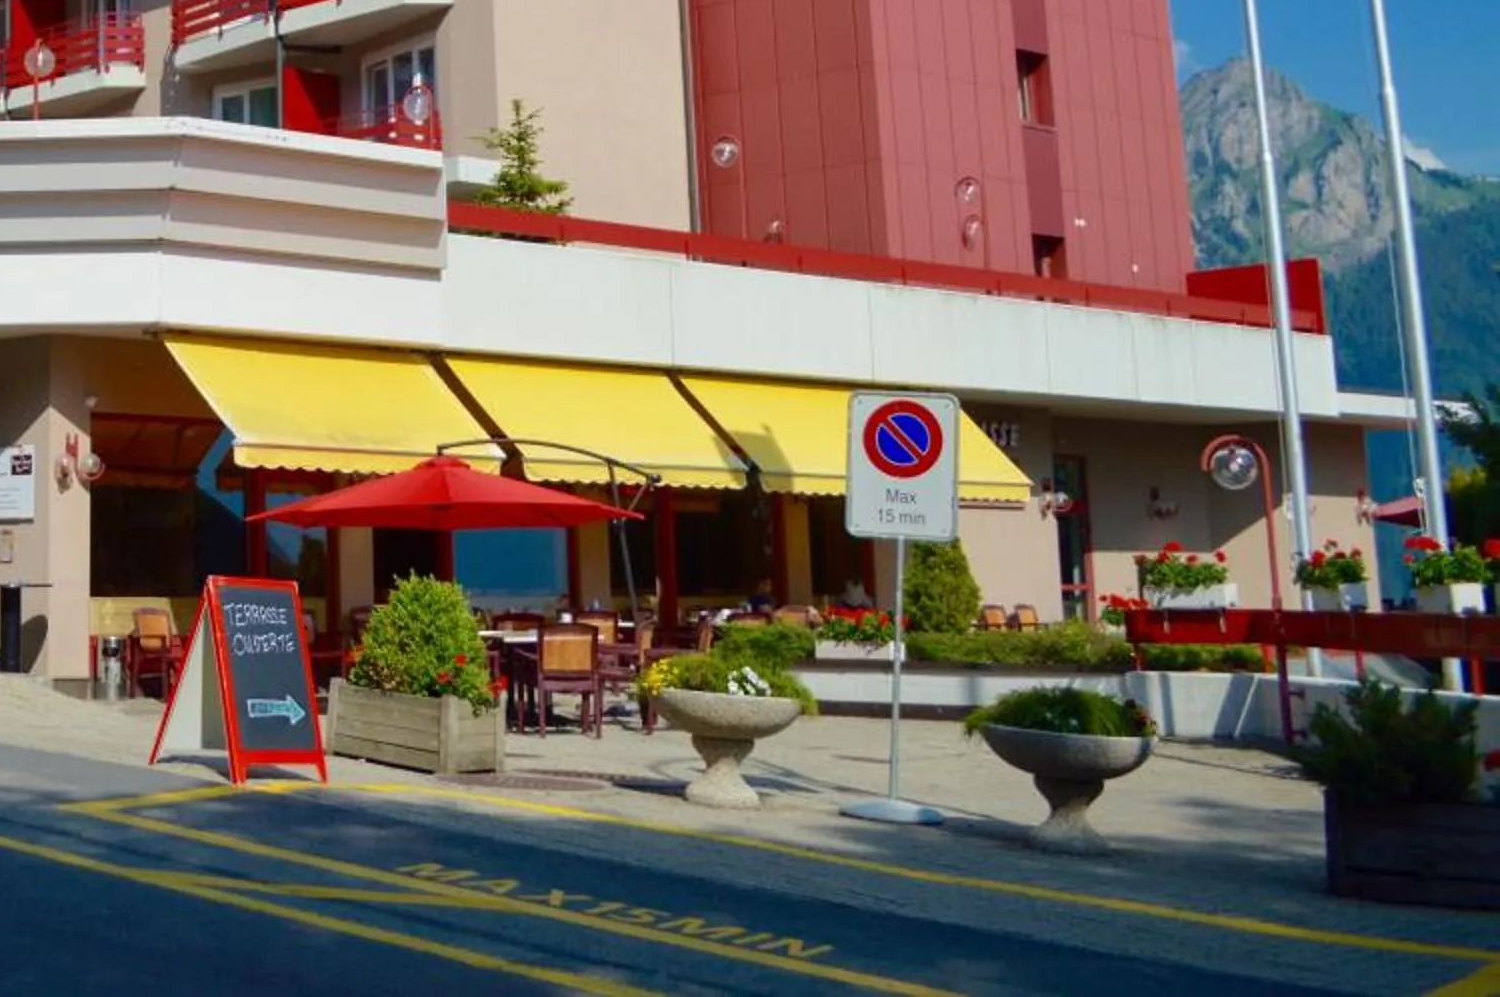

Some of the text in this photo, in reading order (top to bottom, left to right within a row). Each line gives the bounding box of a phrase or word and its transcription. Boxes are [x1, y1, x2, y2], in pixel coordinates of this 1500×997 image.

[885, 488, 917, 504] Max
[878, 509, 926, 525] 15 min
[223, 603, 287, 626] TERRASSE
[233, 632, 296, 656] OUVERTE
[395, 862, 592, 907] MAX
